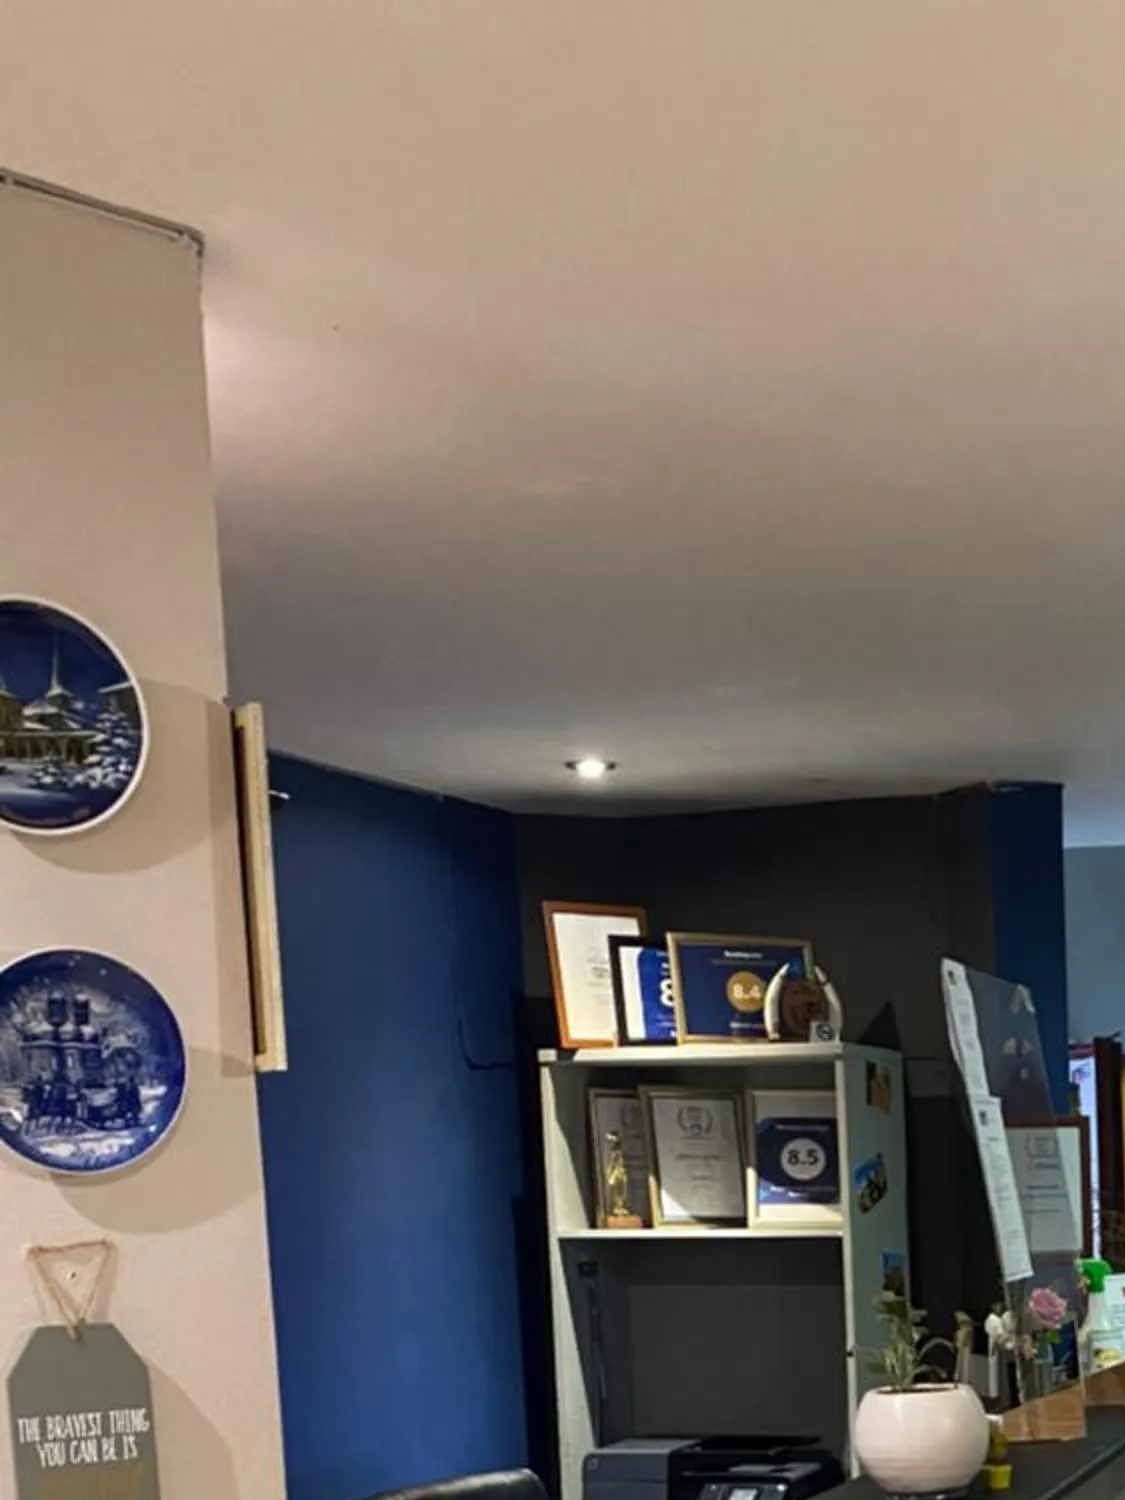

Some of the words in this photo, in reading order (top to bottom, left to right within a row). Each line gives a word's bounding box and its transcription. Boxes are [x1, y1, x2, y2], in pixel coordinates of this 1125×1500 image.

[733, 984, 761, 999] 8.4
[787, 1148, 819, 1166] 8.5
[17, 1417, 41, 1444] THE
[45, 1412, 102, 1440] BRAVEST
[108, 1408, 150, 1434] THING
[36, 1442, 67, 1469] YOU
[69, 1439, 98, 1464] CAN
[101, 1436, 118, 1462] BE
[123, 1435, 138, 1460] IS
